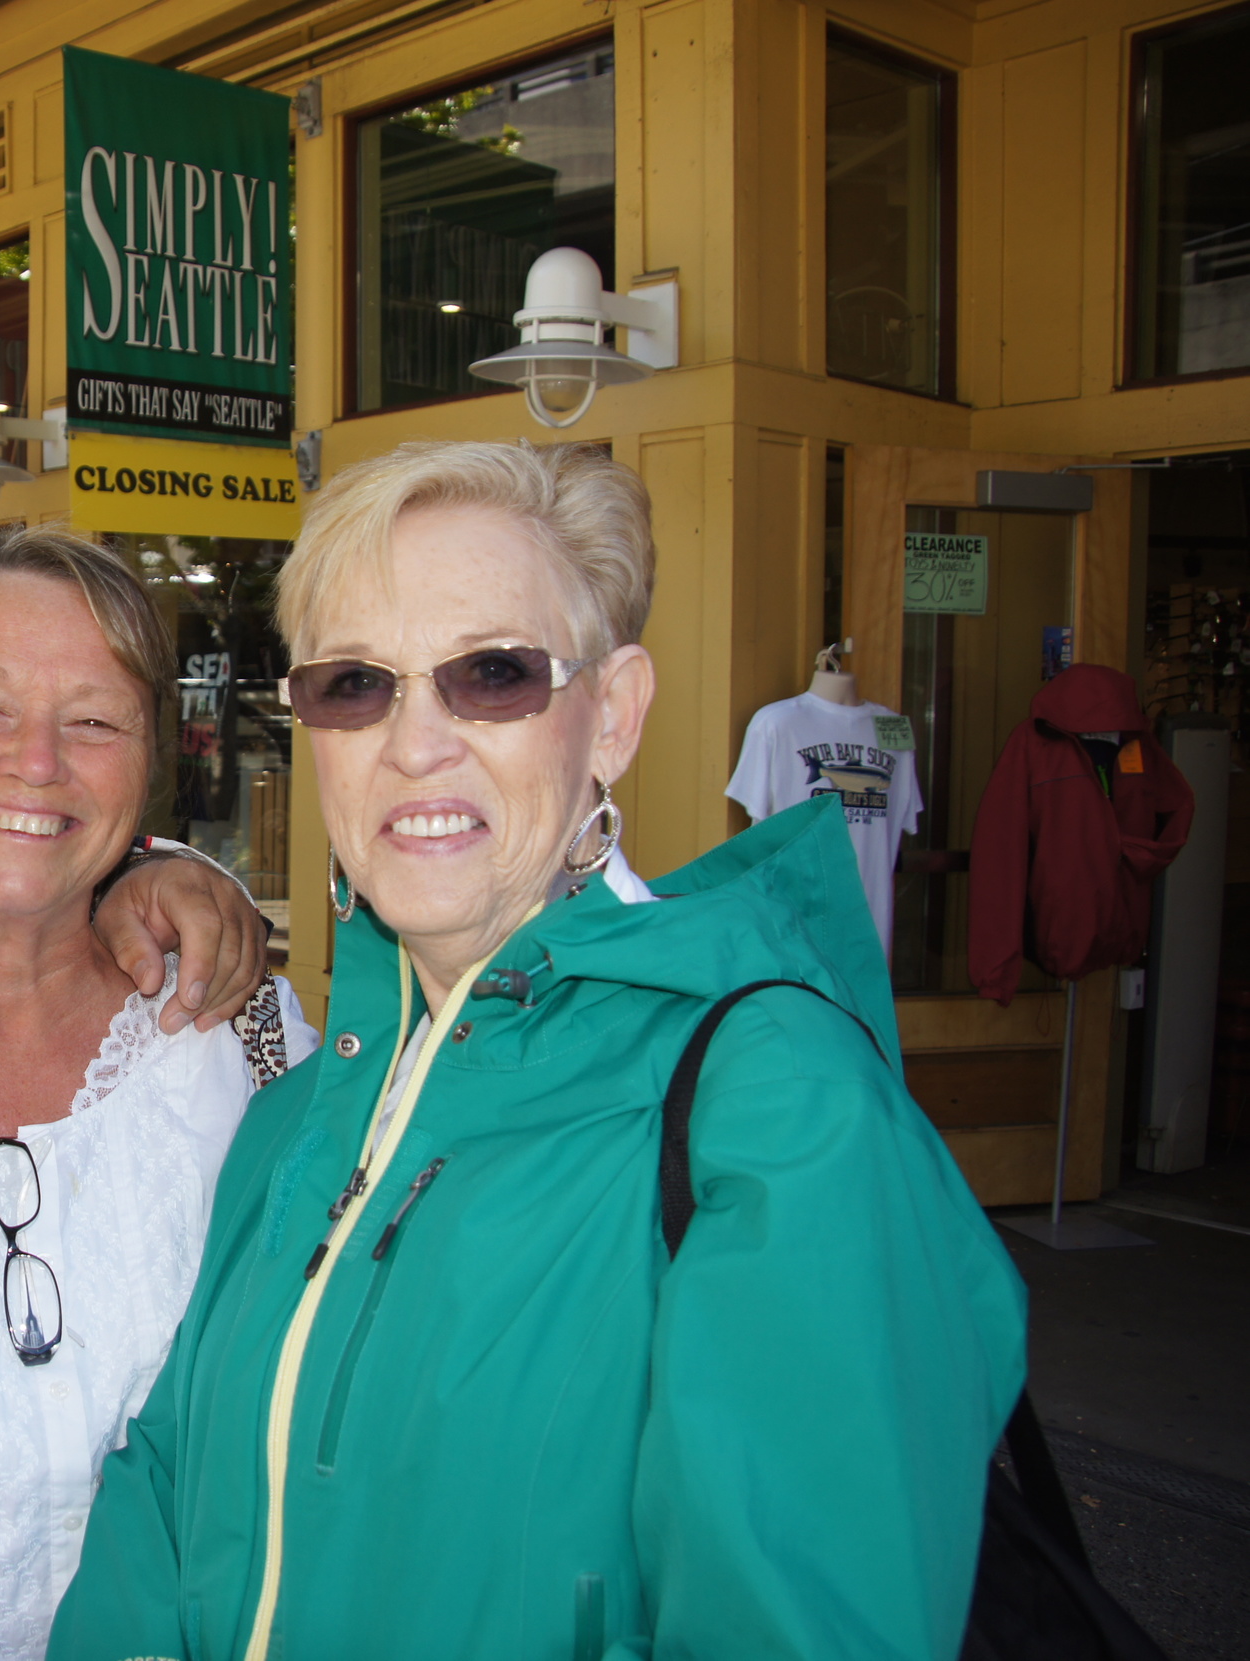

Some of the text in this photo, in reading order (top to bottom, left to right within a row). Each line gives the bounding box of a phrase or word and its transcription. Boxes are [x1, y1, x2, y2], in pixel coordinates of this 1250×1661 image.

[81, 146, 278, 342] SIMPLY!
[81, 253, 278, 366] SEATTLE
[77, 378, 283, 430] GIFTS THAT SAY "SEATTLE"
[74, 465, 296, 503] CLOSING SALE
[904, 536, 983, 553] CLEARANCE
[913, 551, 971, 560] GREEN TAGGED
[906, 569, 958, 603] 30%
[958, 579, 975, 587] OFF
[797, 743, 834, 767] YOUR
[835, 743, 864, 761] BAIT
[848, 808, 887, 817] SALMON
